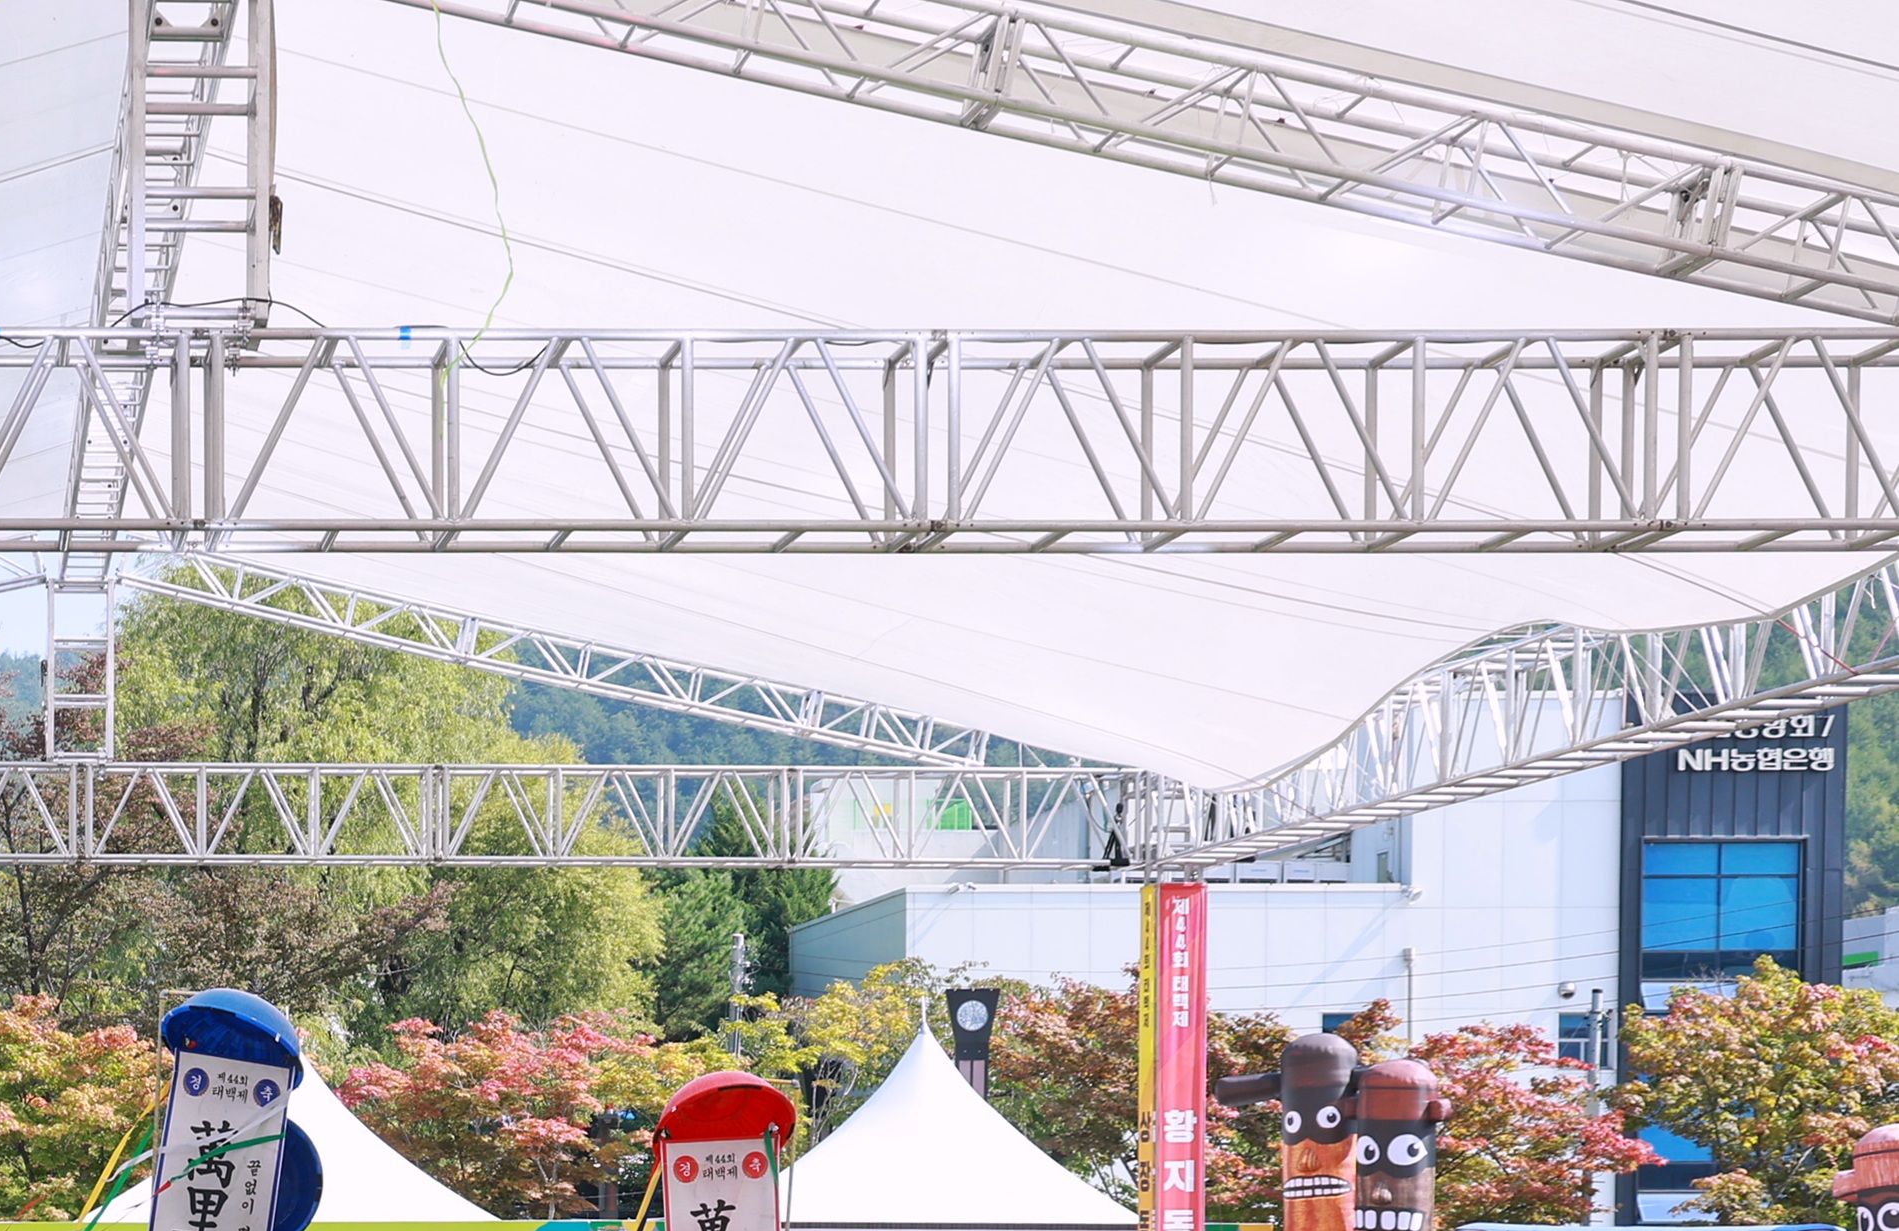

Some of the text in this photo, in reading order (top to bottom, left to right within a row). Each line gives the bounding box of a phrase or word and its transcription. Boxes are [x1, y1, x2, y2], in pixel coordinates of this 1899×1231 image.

[1677, 747, 1835, 772] NH농협은행
[1172, 898, 1190, 1028] 제44회 태백제
[217, 1072, 248, 1085] 제44회
[212, 1085, 248, 1103] 태백제
[705, 1153, 735, 1164] 제44회
[702, 1166, 738, 1181] 태백제
[241, 1160, 262, 1215] 끝없이
